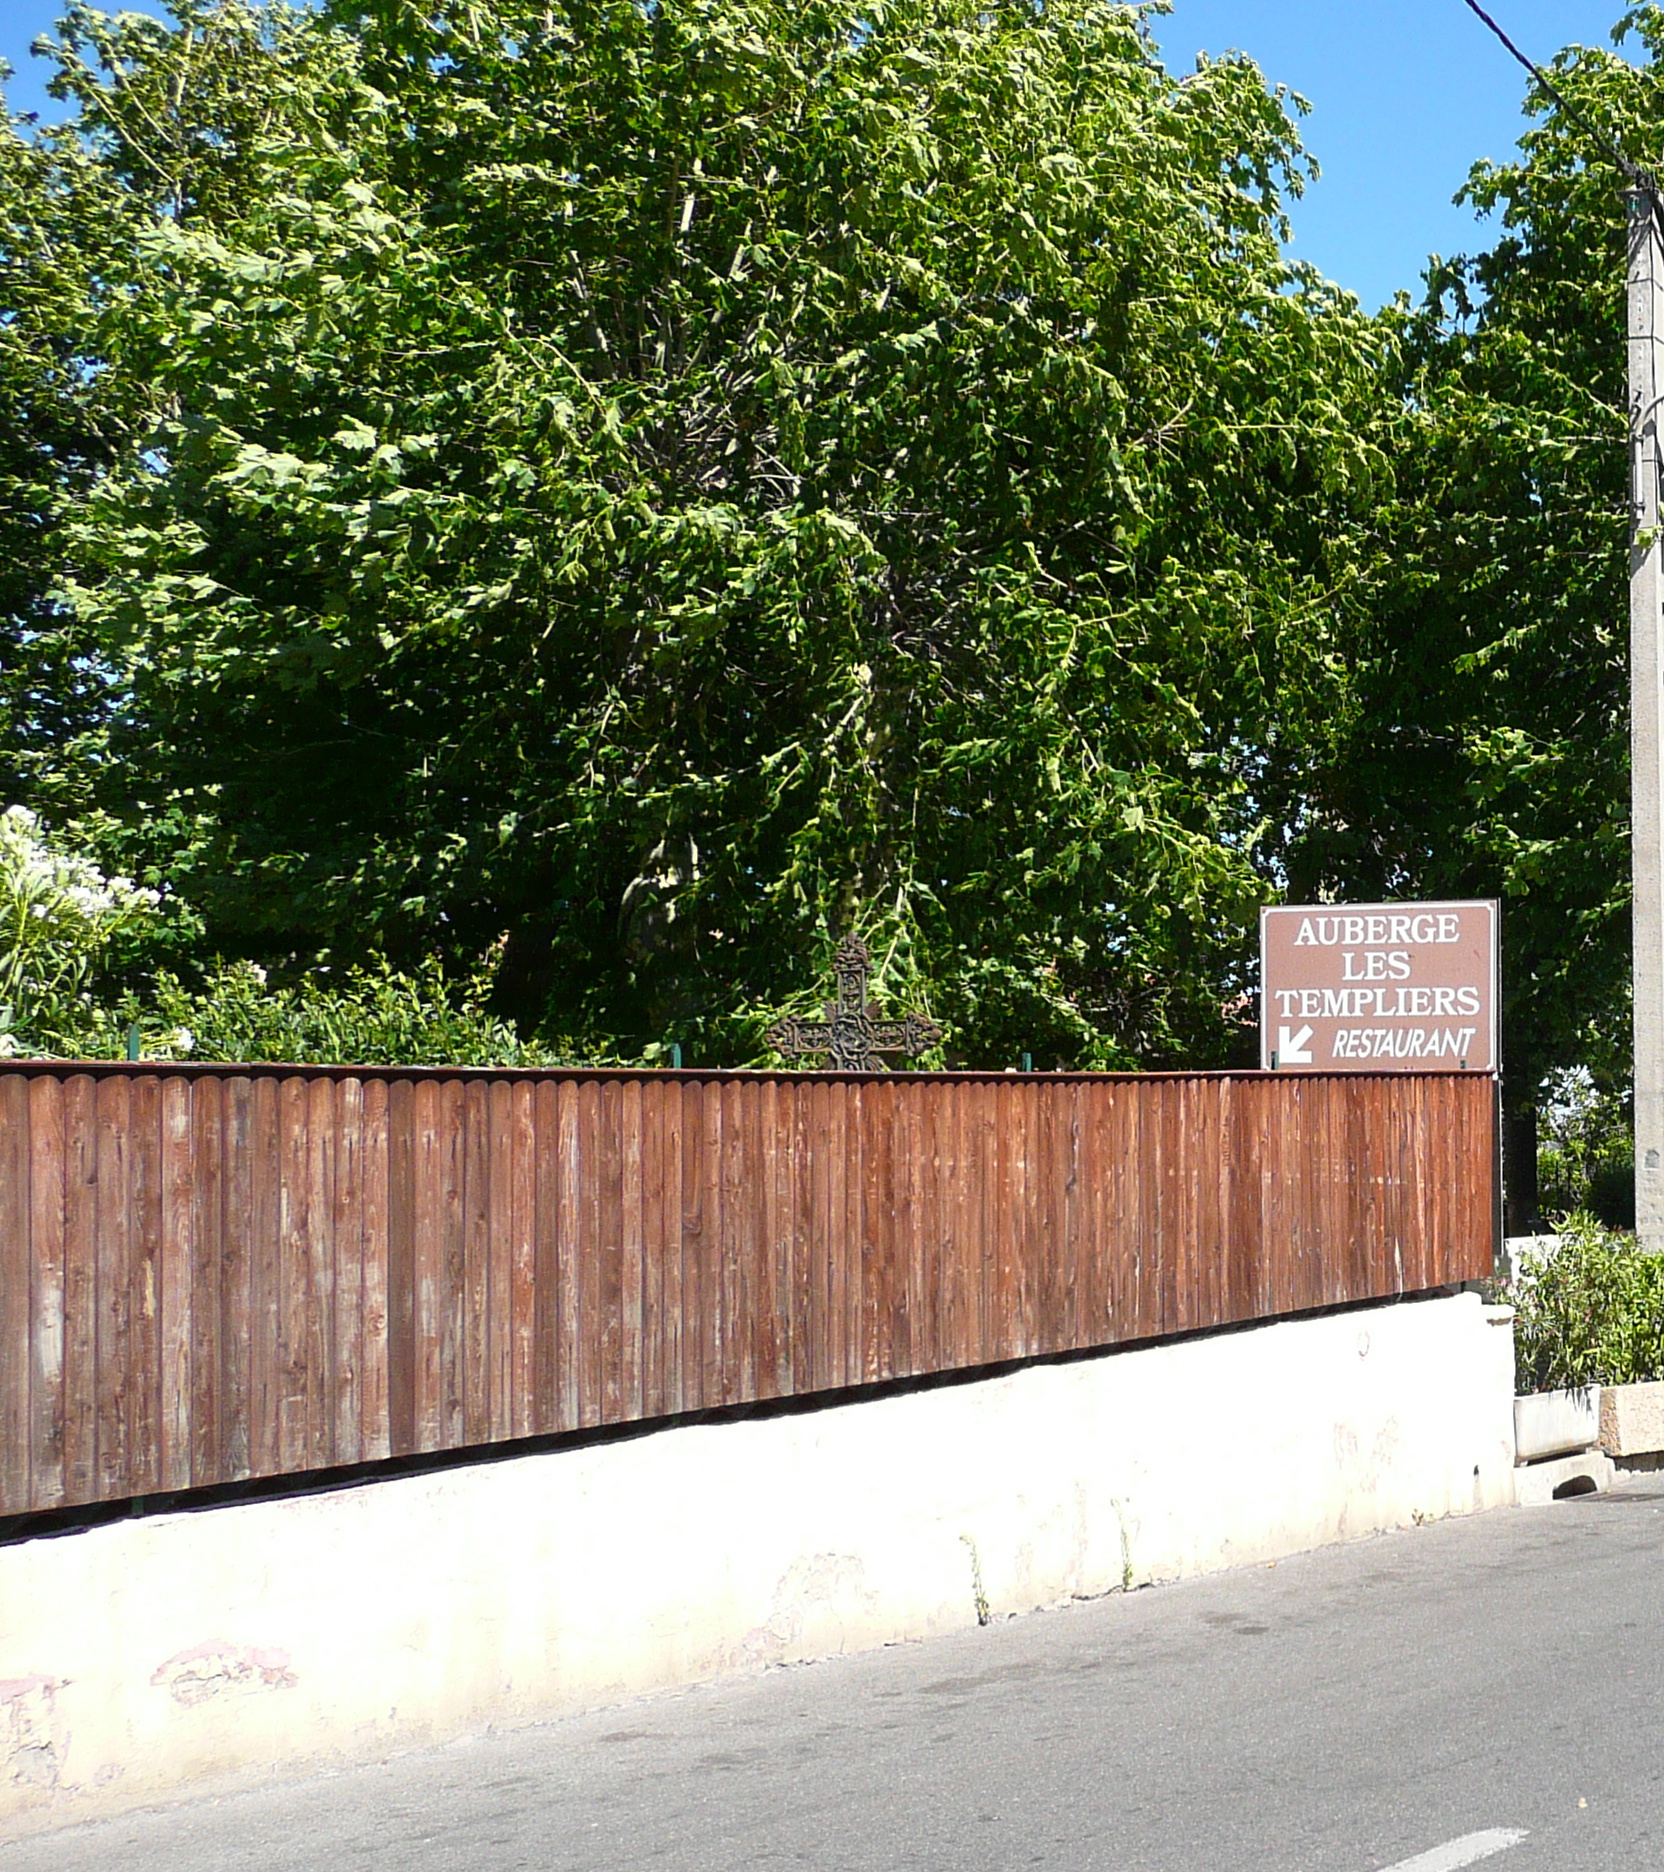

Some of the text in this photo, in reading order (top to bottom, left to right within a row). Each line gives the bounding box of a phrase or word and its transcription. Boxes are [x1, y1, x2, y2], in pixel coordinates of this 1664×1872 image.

[1293, 914, 1460, 946] AUBERGE
[1341, 951, 1411, 981] LES
[1275, 986, 1481, 1018] TEMPLIERS
[1332, 1027, 1477, 1058] RESTAURANT
